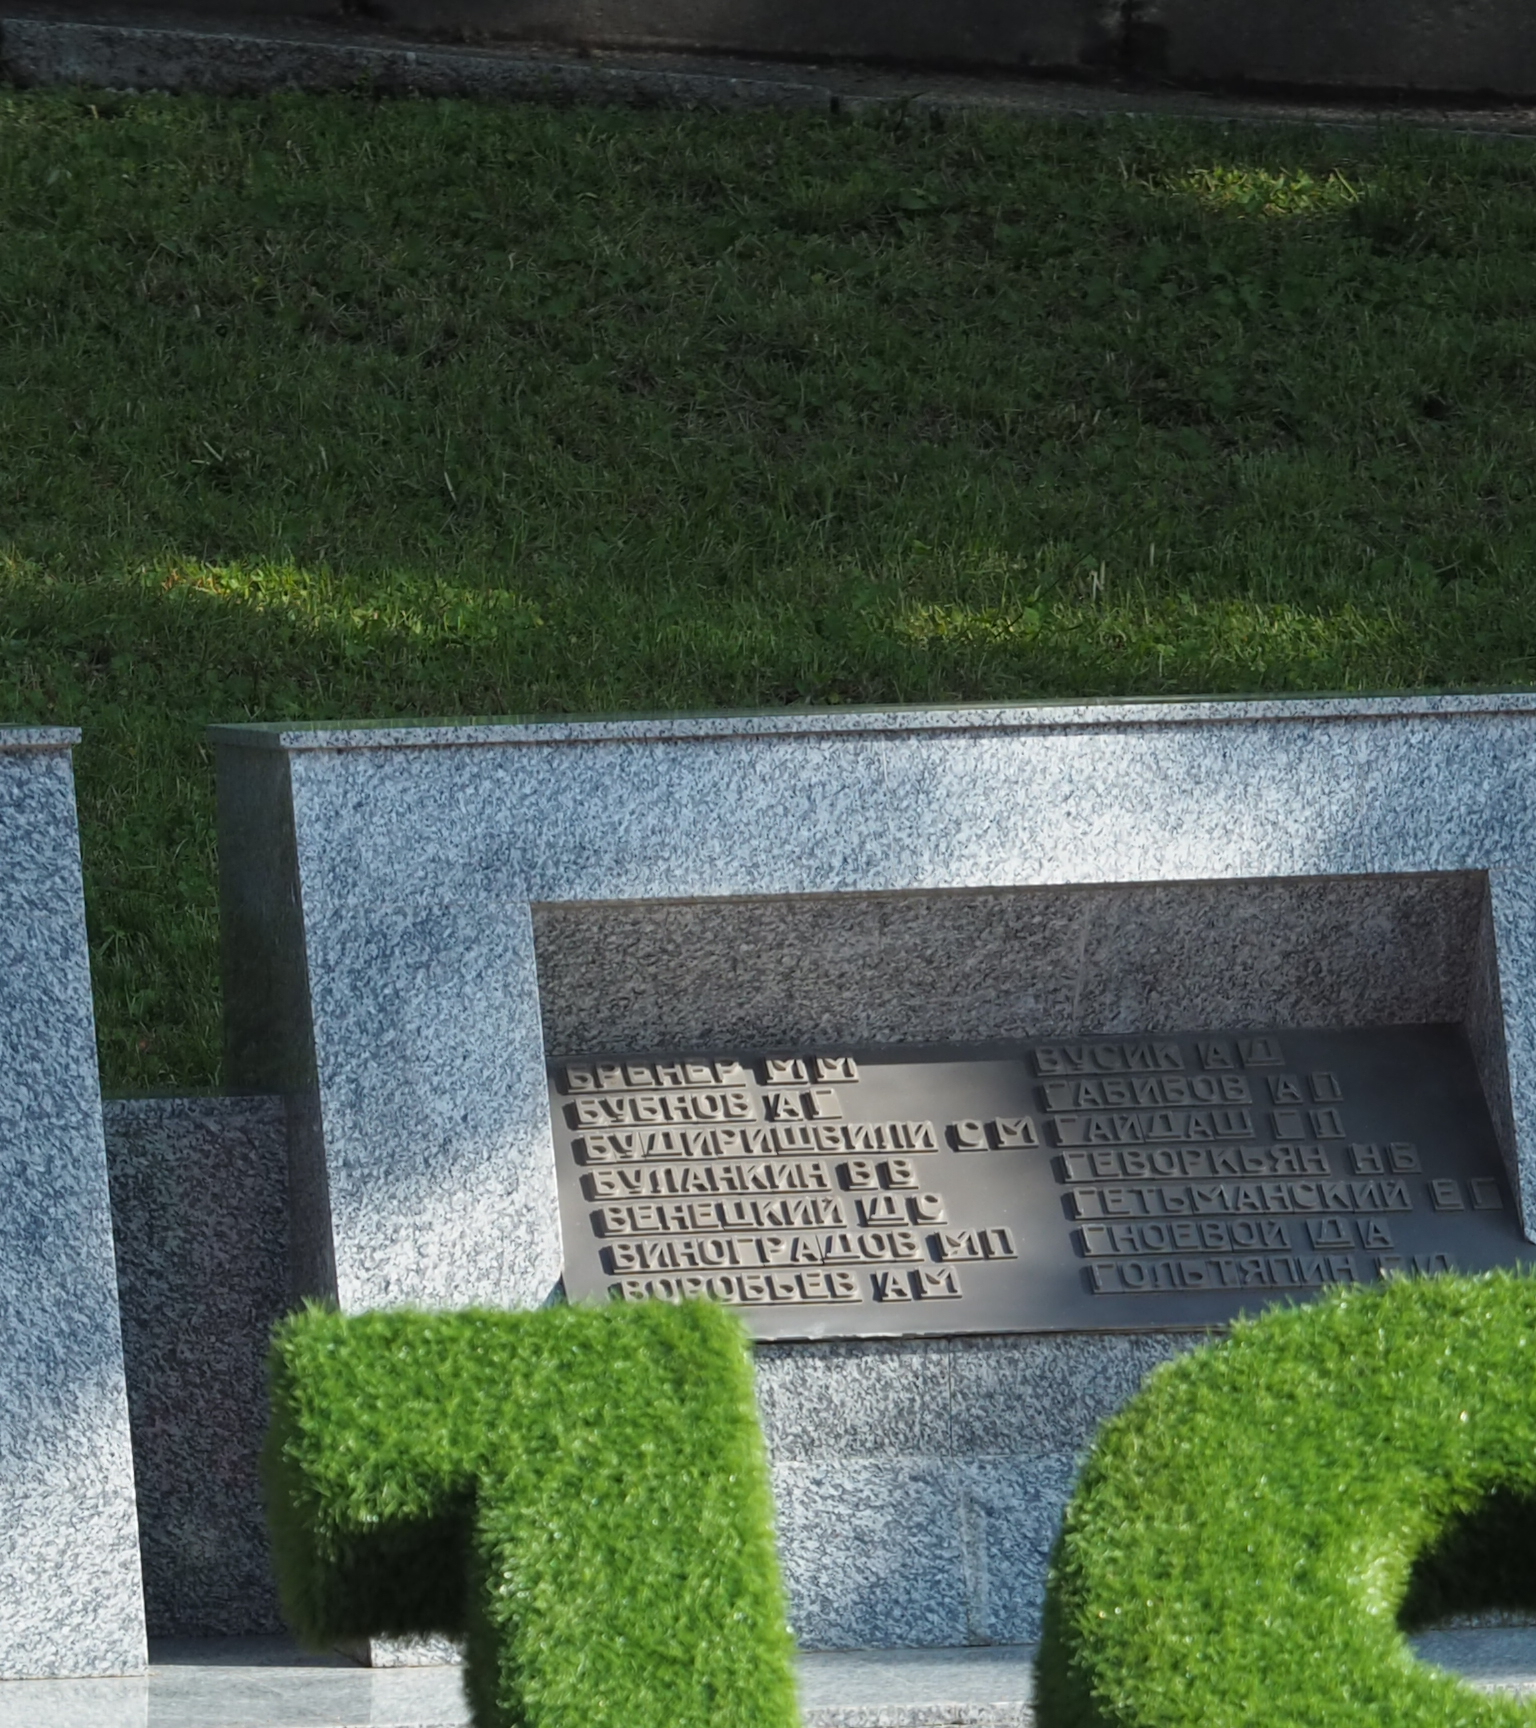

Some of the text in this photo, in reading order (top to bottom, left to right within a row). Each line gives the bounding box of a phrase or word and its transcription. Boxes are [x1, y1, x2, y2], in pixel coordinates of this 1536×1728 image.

[1036, 1045, 1181, 1073] ВУСИК
[577, 1093, 752, 1124] БУБНОВ
[1043, 1076, 1249, 1108] ГАБИВОВ
[1053, 1110, 1253, 1143] ГАЙДАШ
[593, 1161, 829, 1196] БУЛАНКИН
[1064, 1145, 1328, 1179] ГЕВОРКЬЯН
[604, 1196, 844, 1233] ВЕНЕЦКИЙ
[1075, 1179, 1410, 1217] ГЕТЬМАНСКИЙ
[613, 1232, 920, 1270] ВИНОГРАДОВ
[1083, 1220, 1288, 1254] ГНОЕВОЙ
[1092, 1255, 1355, 1291] ГОЛЬТЯПИН
